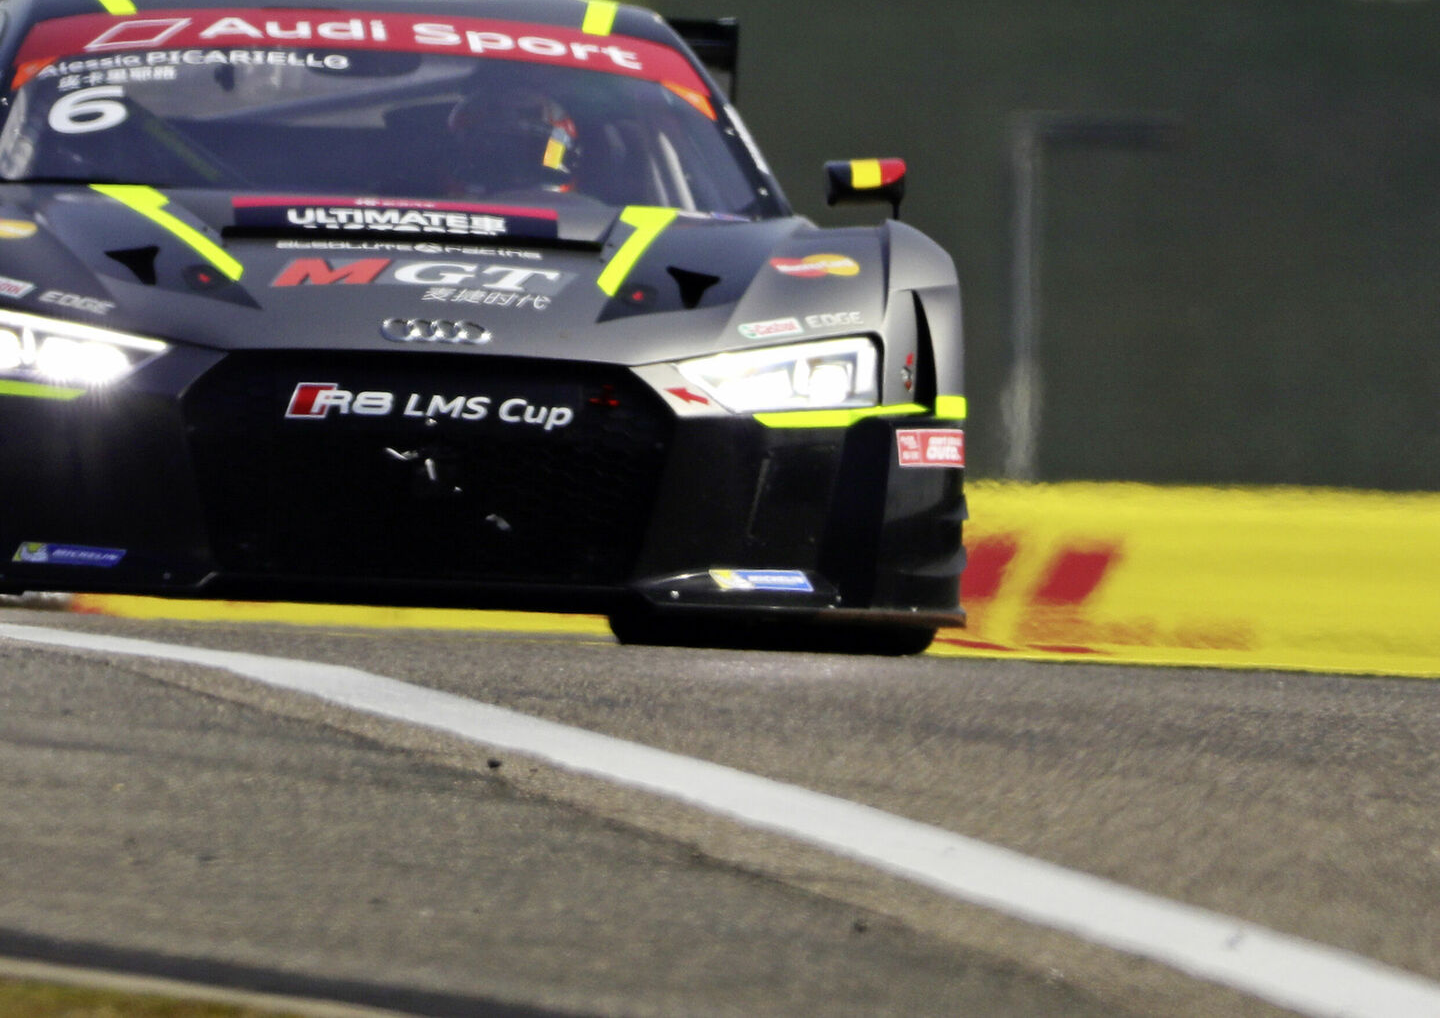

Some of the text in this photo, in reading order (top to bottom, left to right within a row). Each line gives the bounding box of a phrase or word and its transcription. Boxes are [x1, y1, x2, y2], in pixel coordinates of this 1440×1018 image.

[145, 49, 350, 70] PICARIELLO
[198, 15, 644, 70] Audi Sport
[47, 86, 128, 134] 6
[805, 311, 864, 329] EDGE
[311, 388, 575, 431] R8 LMS Cup
